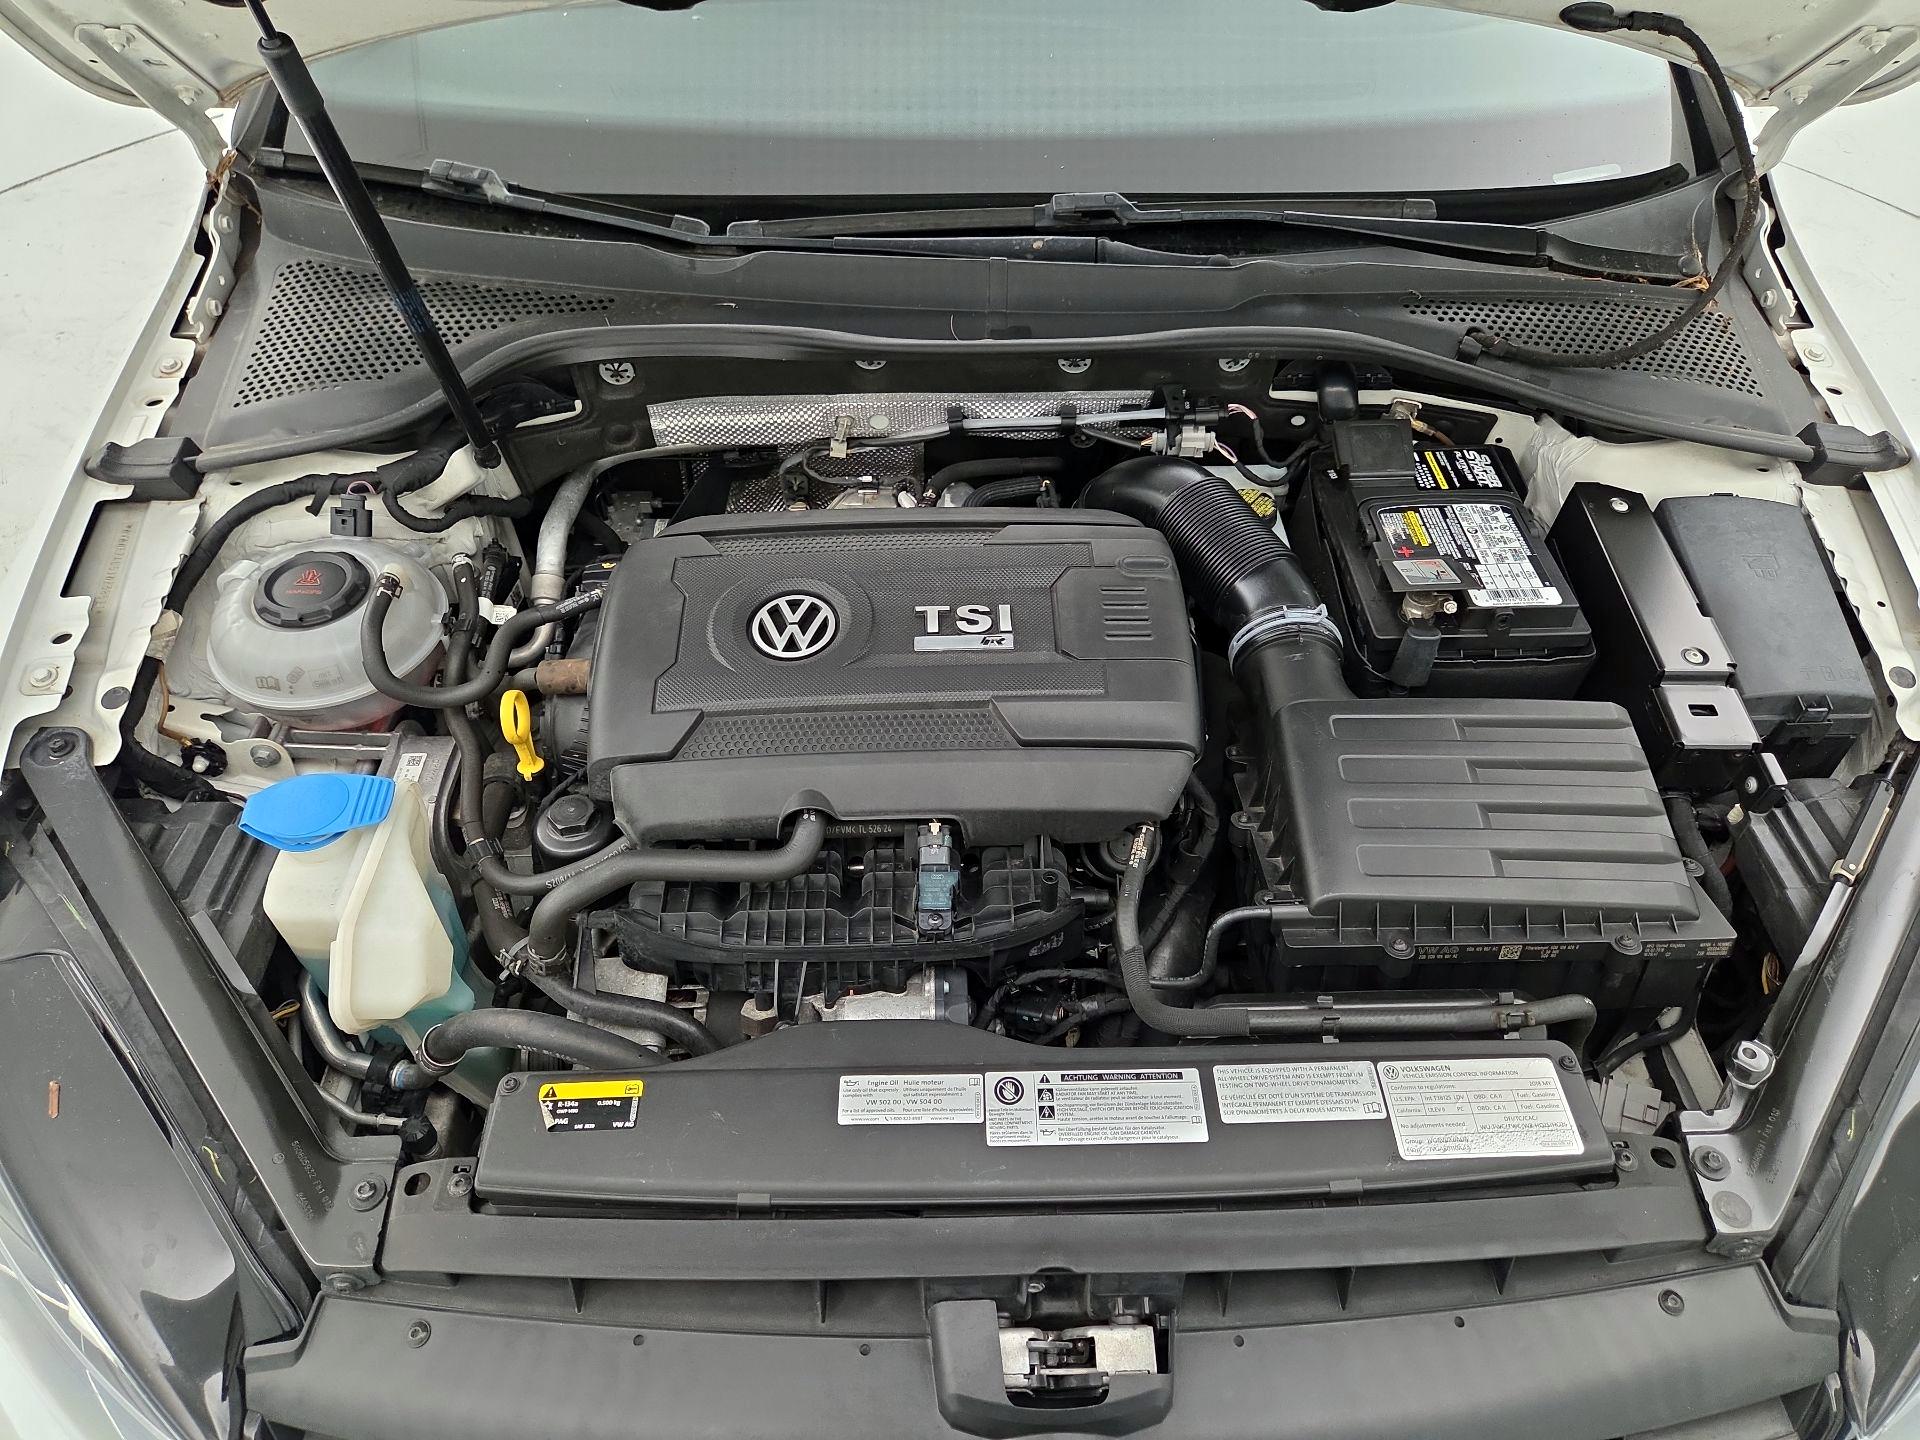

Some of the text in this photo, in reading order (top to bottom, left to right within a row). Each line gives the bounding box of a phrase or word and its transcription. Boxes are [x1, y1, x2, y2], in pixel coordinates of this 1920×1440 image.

[1463, 450, 1488, 487] START
[1480, 454, 1502, 488] SUPER
[915, 604, 1012, 633] TSI
[868, 824, 881, 833] 526
[884, 824, 892, 832] 24
